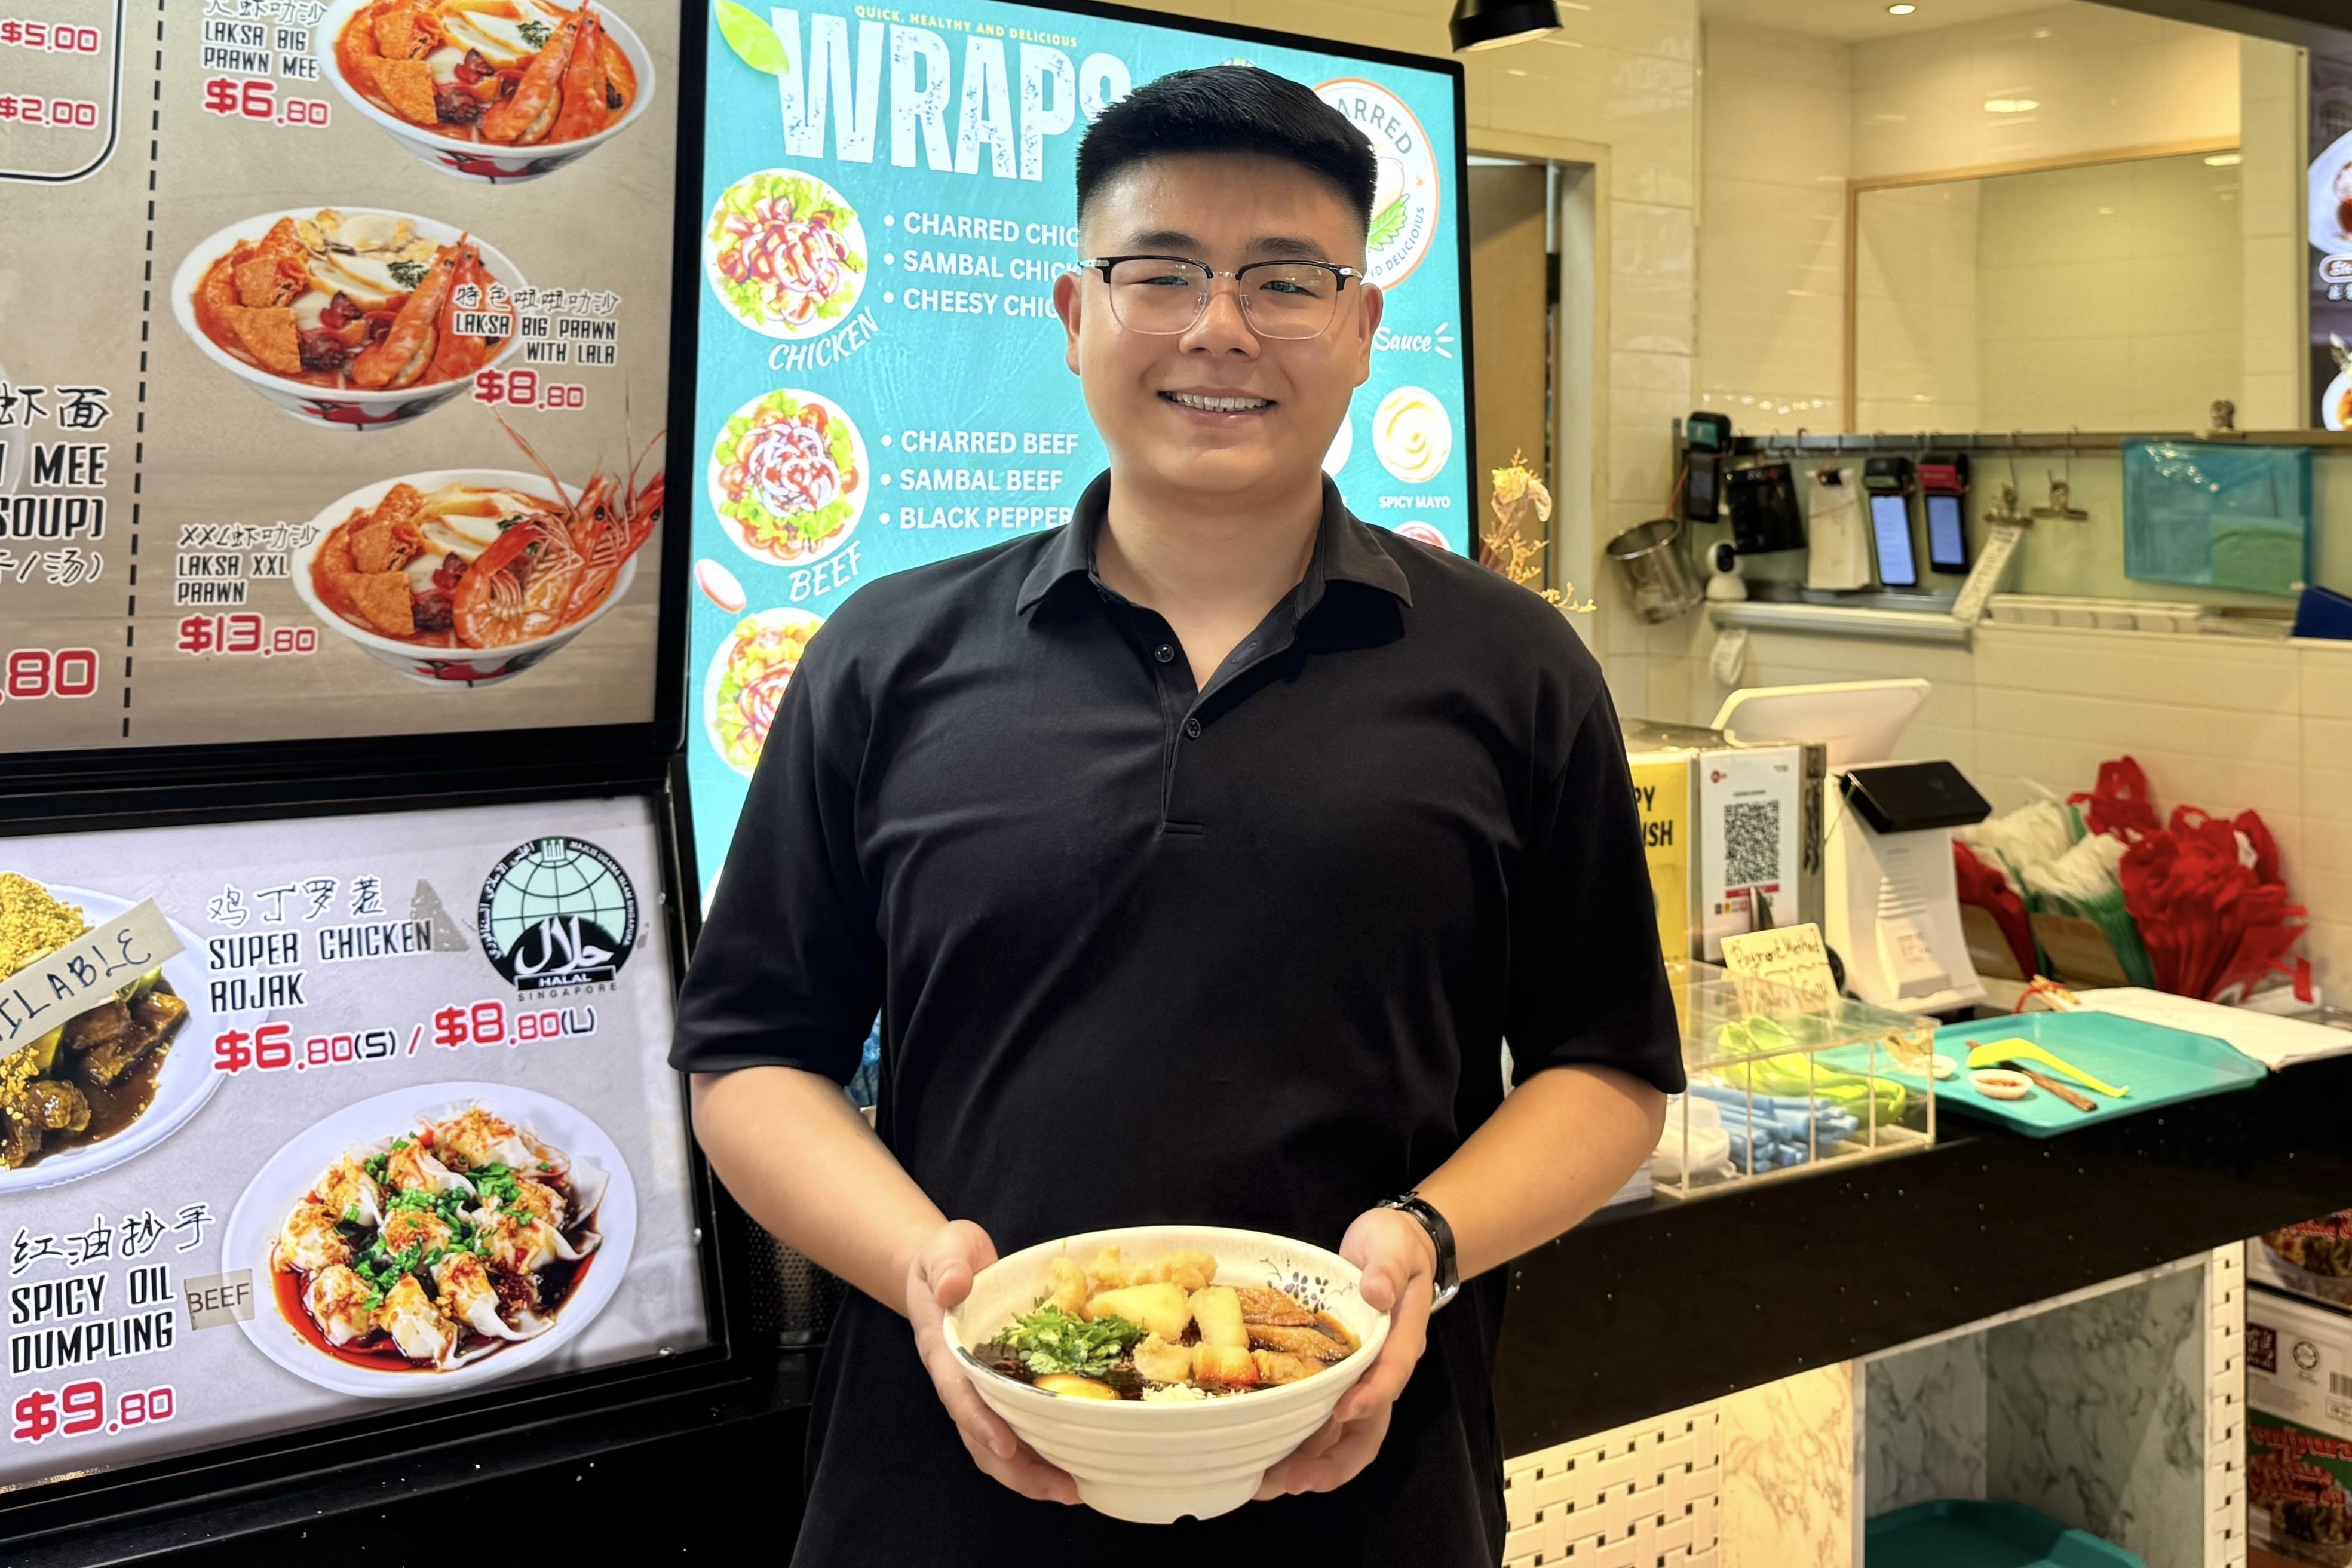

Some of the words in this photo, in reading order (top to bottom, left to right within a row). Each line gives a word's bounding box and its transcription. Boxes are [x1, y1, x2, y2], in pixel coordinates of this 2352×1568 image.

[1, 21, 97, 52] $5.00
[205, 21, 265, 46] LAKSA
[278, 30, 306, 51] BIG
[910, 13, 971, 32] HEALTHY
[976, 24, 1005, 37] AND
[1010, 30, 1077, 48] DELICIOUS
[204, 47, 269, 73] PRAWN
[283, 56, 317, 78] MEE
[0, 96, 96, 127] $2.00
[205, 78, 327, 125] $6.80
[904, 211, 1020, 243] CHARRED
[903, 249, 1004, 278] SAMBAL
[903, 287, 998, 315] CHEESY
[456, 313, 510, 335] LAKSA
[522, 317, 548, 336] BIG
[560, 319, 615, 340] PRAWN
[768, 306, 879, 372] CHICKEN
[1374, 326, 1432, 352] Sauce
[527, 342, 566, 361] WITH
[578, 345, 614, 364] LALA
[474, 370, 584, 409] $8.80
[901, 429, 1017, 453] CHARRED
[1023, 432, 1079, 455] BEEF
[34, 445, 107, 484] MEE
[900, 468, 1001, 491] SAMBAL
[1007, 469, 1063, 491] BEEF
[1379, 495, 1414, 508] SPICY
[1415, 495, 1451, 508] MAYO
[900, 507, 980, 529] BLACK
[986, 507, 1073, 529] PEPPER
[179, 555, 239, 576] LAKSA
[253, 555, 288, 576] XXL
[787, 539, 864, 602] BEEF
[178, 581, 245, 603] PRAWN
[178, 615, 315, 655] $13.80
[210, 932, 298, 970] SUPER
[320, 920, 431, 960] CHICKEN
[514, 914, 614, 975] حلال
[0, 928, 151, 1041] ILABLE
[211, 972, 305, 1012] ROJAK
[518, 983, 617, 1002] SINGAPORE
[539, 974, 593, 987] HALAL
[13, 1205, 213, 1275] 红油抄手
[11, 1275, 105, 1324] SPICY
[130, 1266, 174, 1305] OIL
[188, 1282, 250, 1312] BEEF
[12, 1311, 173, 1373] DUMPLING
[14, 1381, 173, 1441] $9.80
